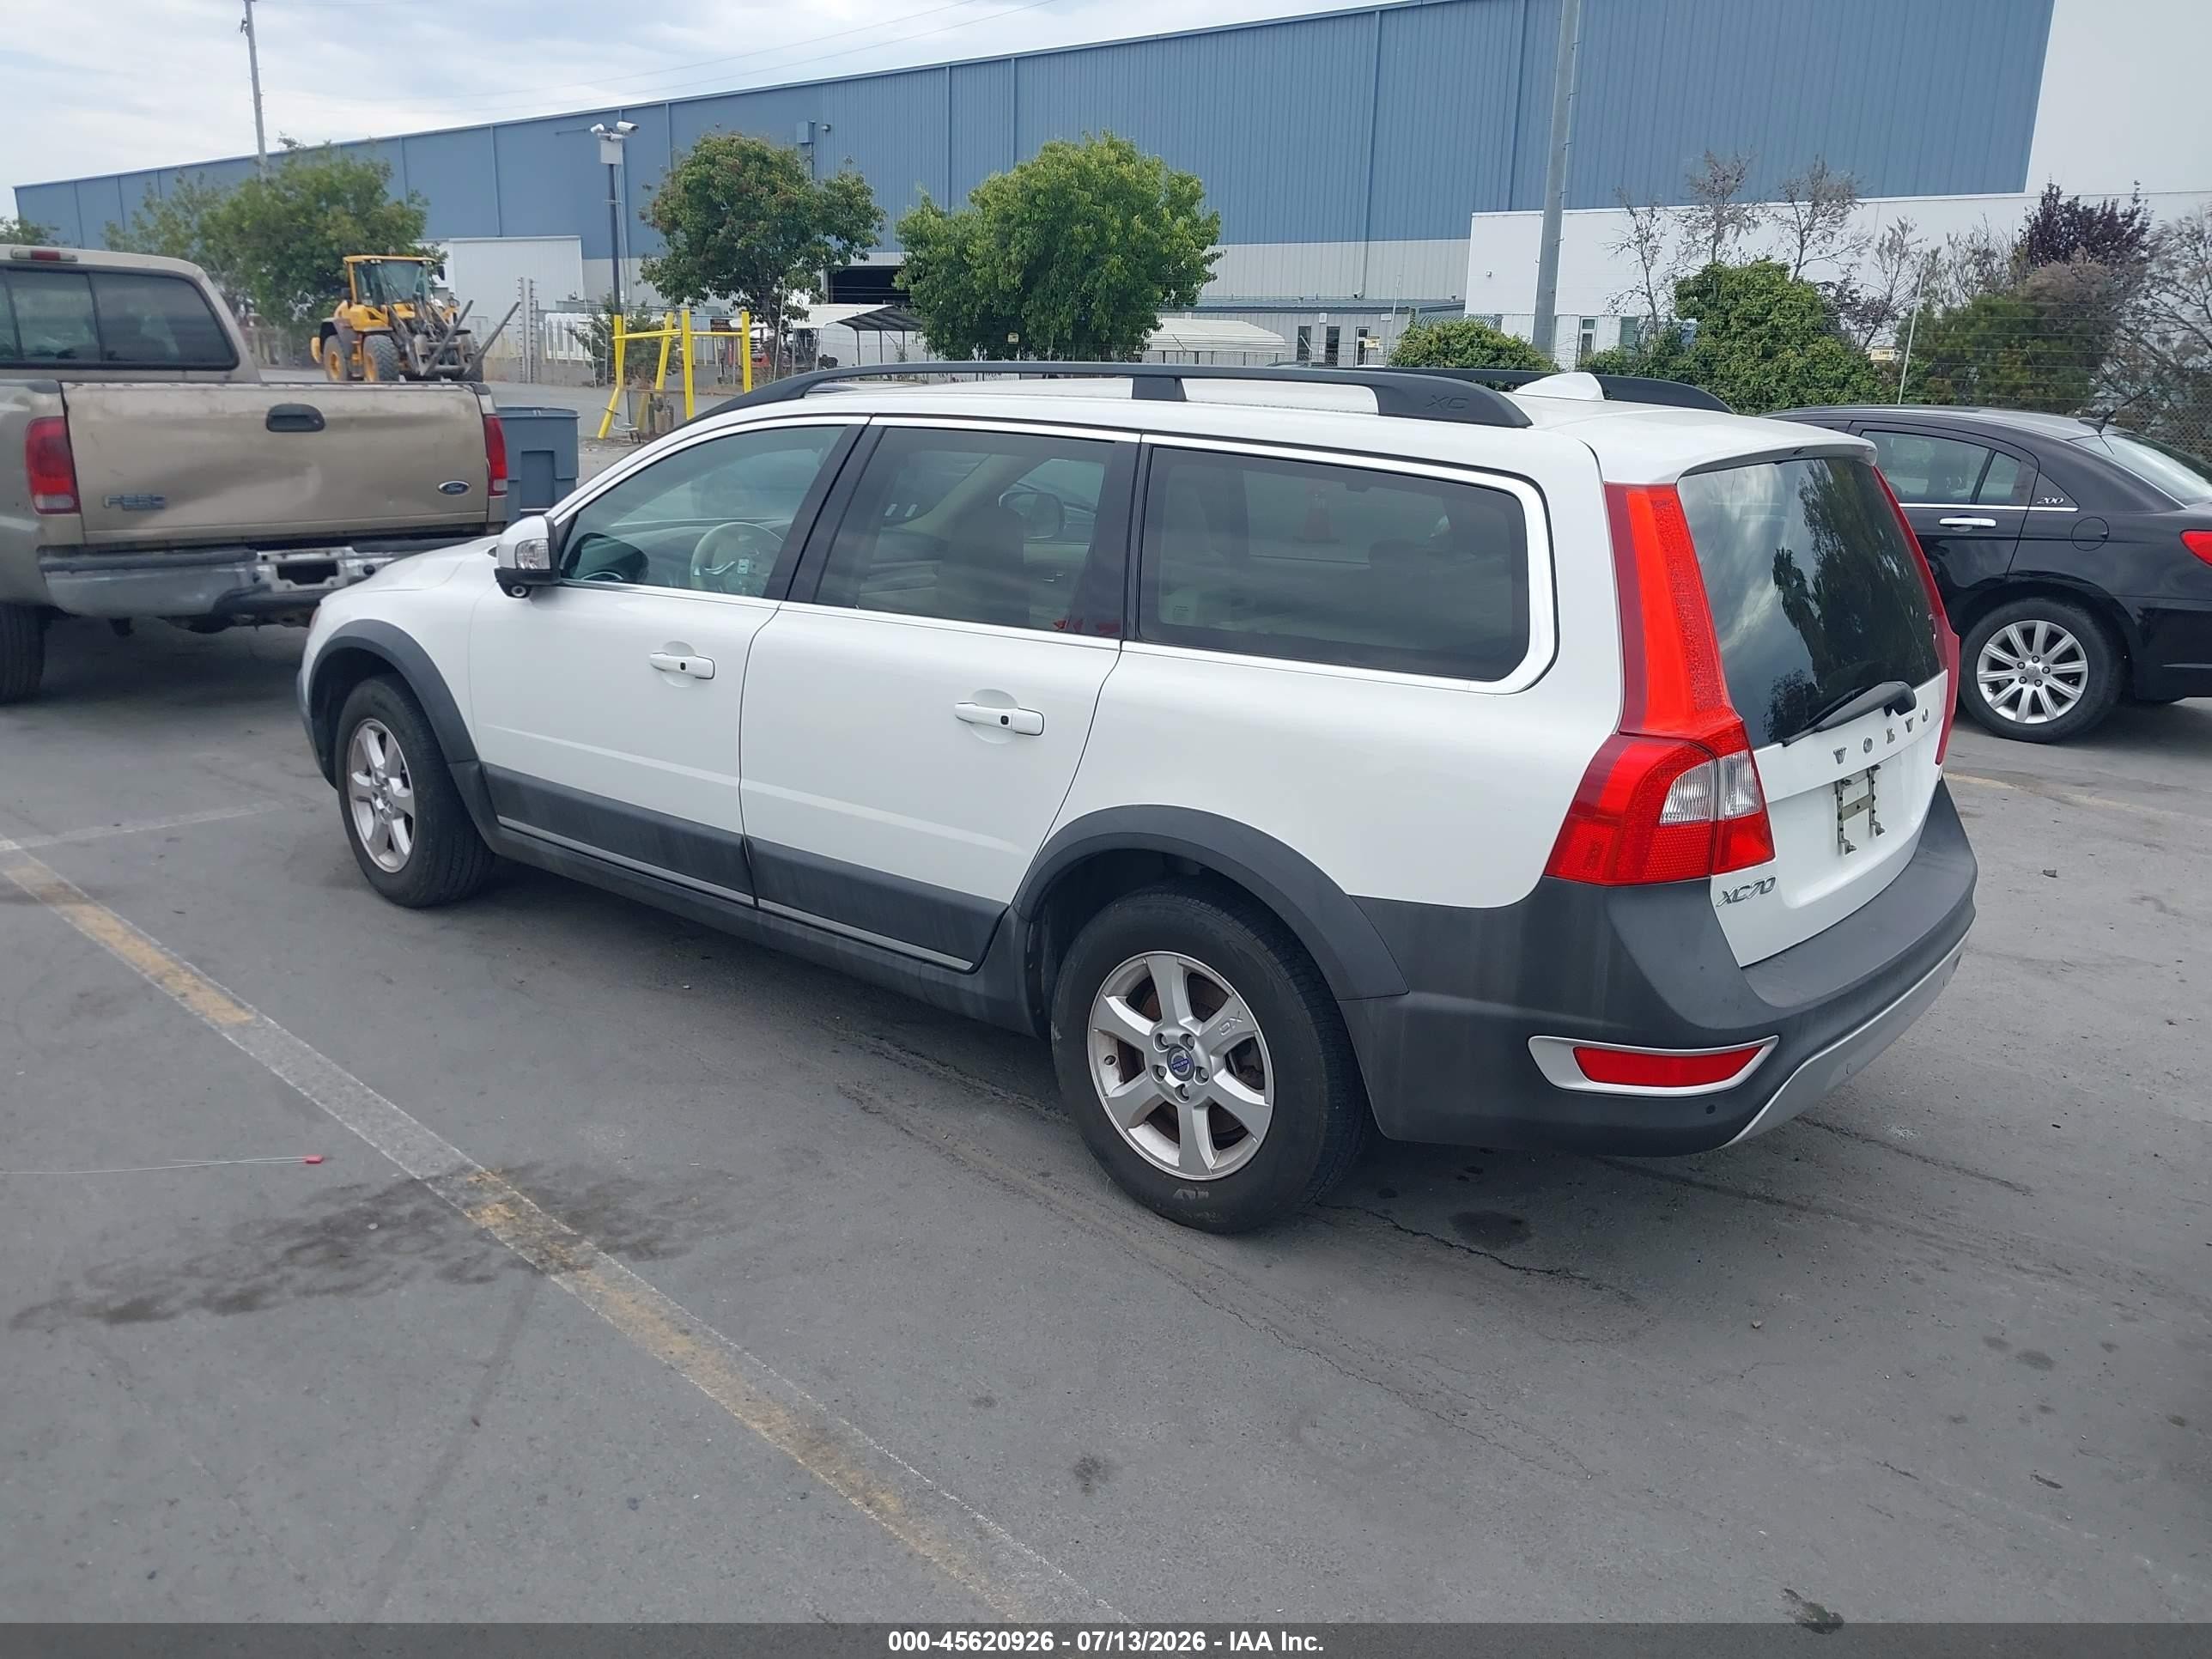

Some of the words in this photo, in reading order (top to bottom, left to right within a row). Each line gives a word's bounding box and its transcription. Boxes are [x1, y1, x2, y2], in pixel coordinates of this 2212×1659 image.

[1425, 394, 1470, 410] XC
[1833, 708, 1929, 764] VOLVO
[1716, 876, 1777, 907] XC70
